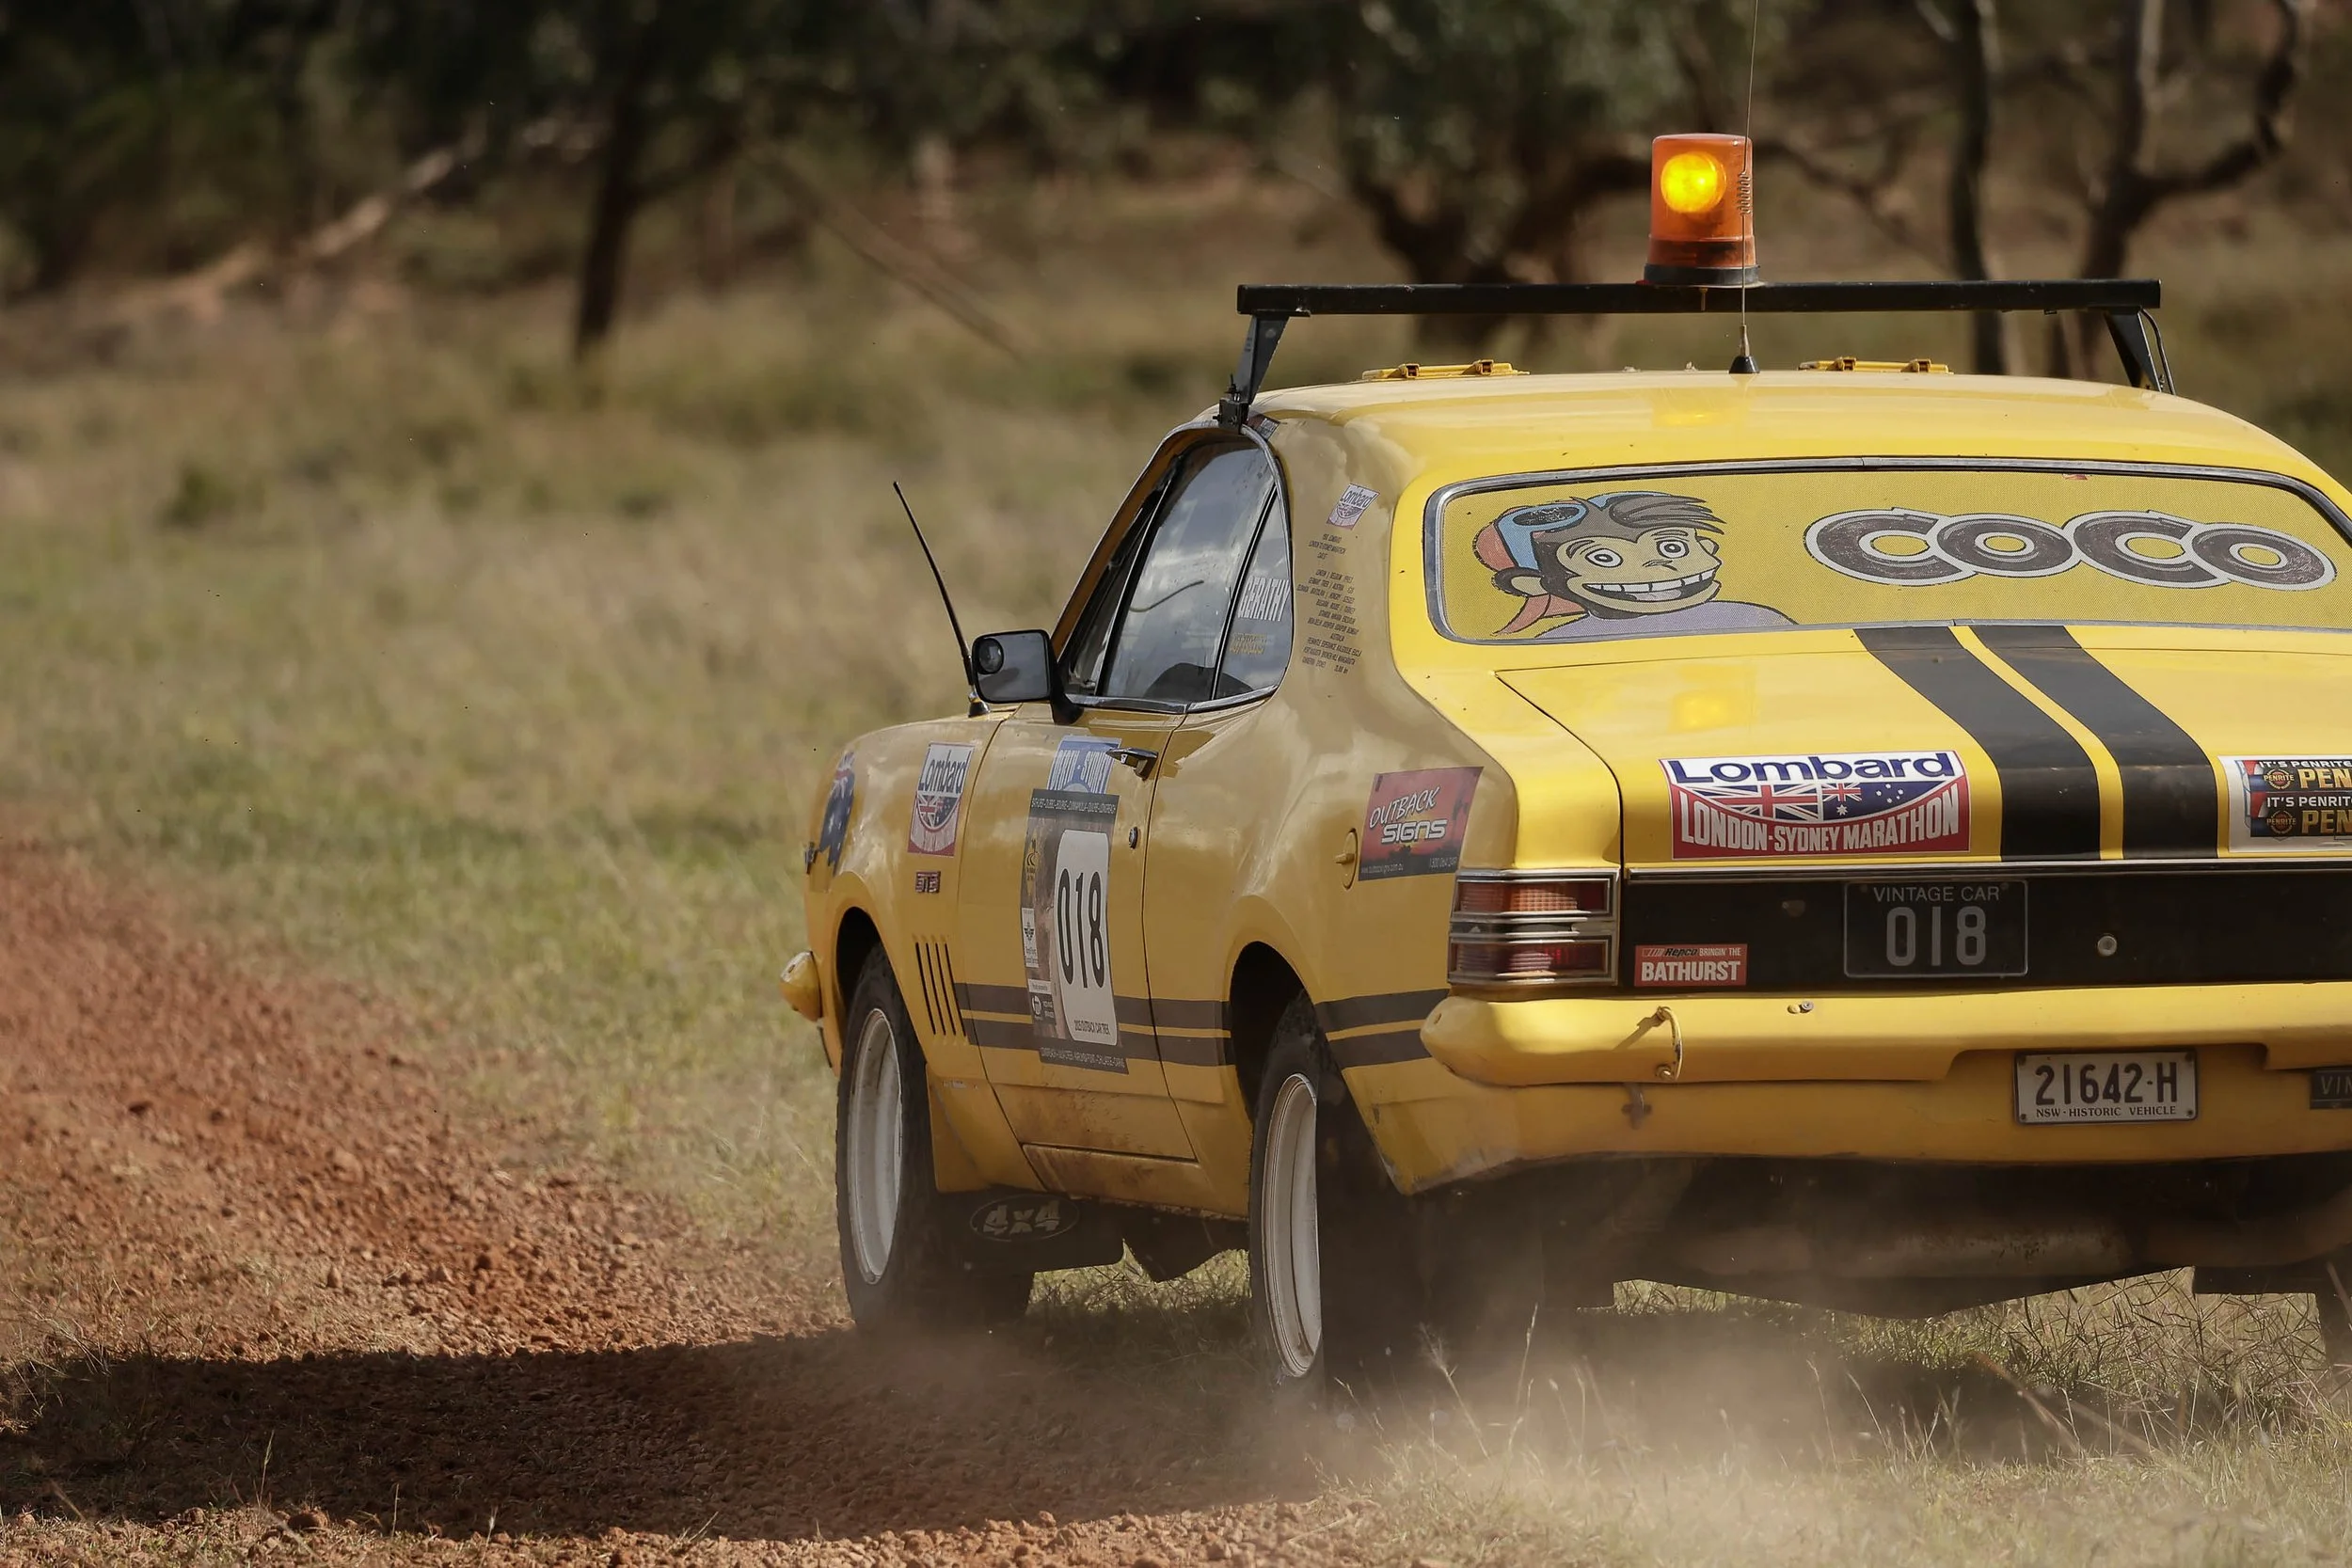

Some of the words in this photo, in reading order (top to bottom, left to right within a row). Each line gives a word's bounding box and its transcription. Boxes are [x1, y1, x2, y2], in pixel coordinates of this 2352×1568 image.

[1340, 485, 1377, 508] Lombard
[1238, 576, 1290, 621] GERATHY
[918, 747, 971, 794] Lombard
[1668, 752, 1955, 784] Lombard
[1369, 786, 1440, 829] OUTBACK
[1843, 782, 1959, 850] MARATHON
[2267, 797, 2294, 807] IT'S
[2299, 797, 2352, 807] PENRIT
[1381, 819, 1448, 845] SIGNS
[1874, 886, 1956, 903] VINTAGE
[1962, 886, 1999, 903] CAR
[1057, 868, 1104, 989] 018
[1886, 906, 1987, 967] 018
[1665, 948, 1697, 958] Repco
[1642, 960, 1740, 981] BATHURST
[2129, 1105, 2177, 1117] VEHICLE
[983, 1200, 1061, 1235] 4x4
